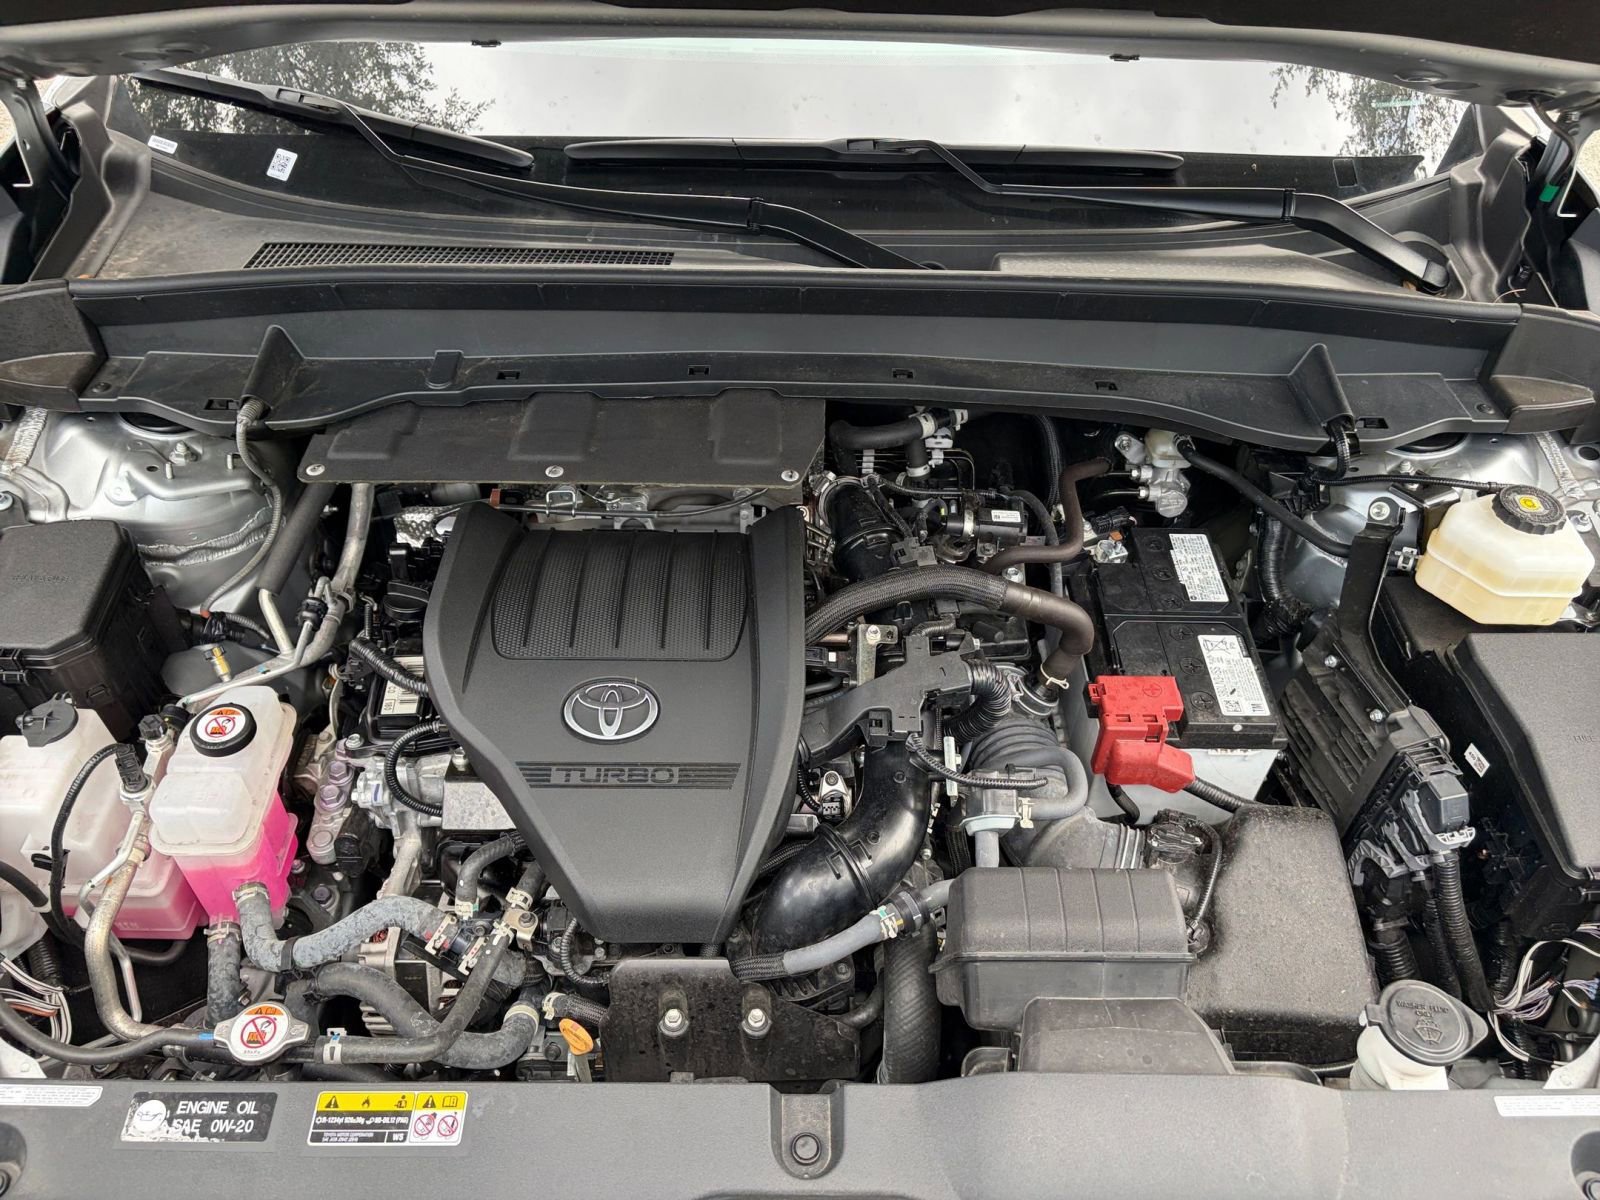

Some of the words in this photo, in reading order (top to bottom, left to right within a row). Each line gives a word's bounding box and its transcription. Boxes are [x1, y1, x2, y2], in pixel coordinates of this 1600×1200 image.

[555, 767, 674, 784] TURBO
[176, 1100, 229, 1114] ENGINE
[236, 1100, 259, 1114] OIL
[172, 1118, 202, 1132] SAE
[210, 1119, 254, 1132] 0W-20
